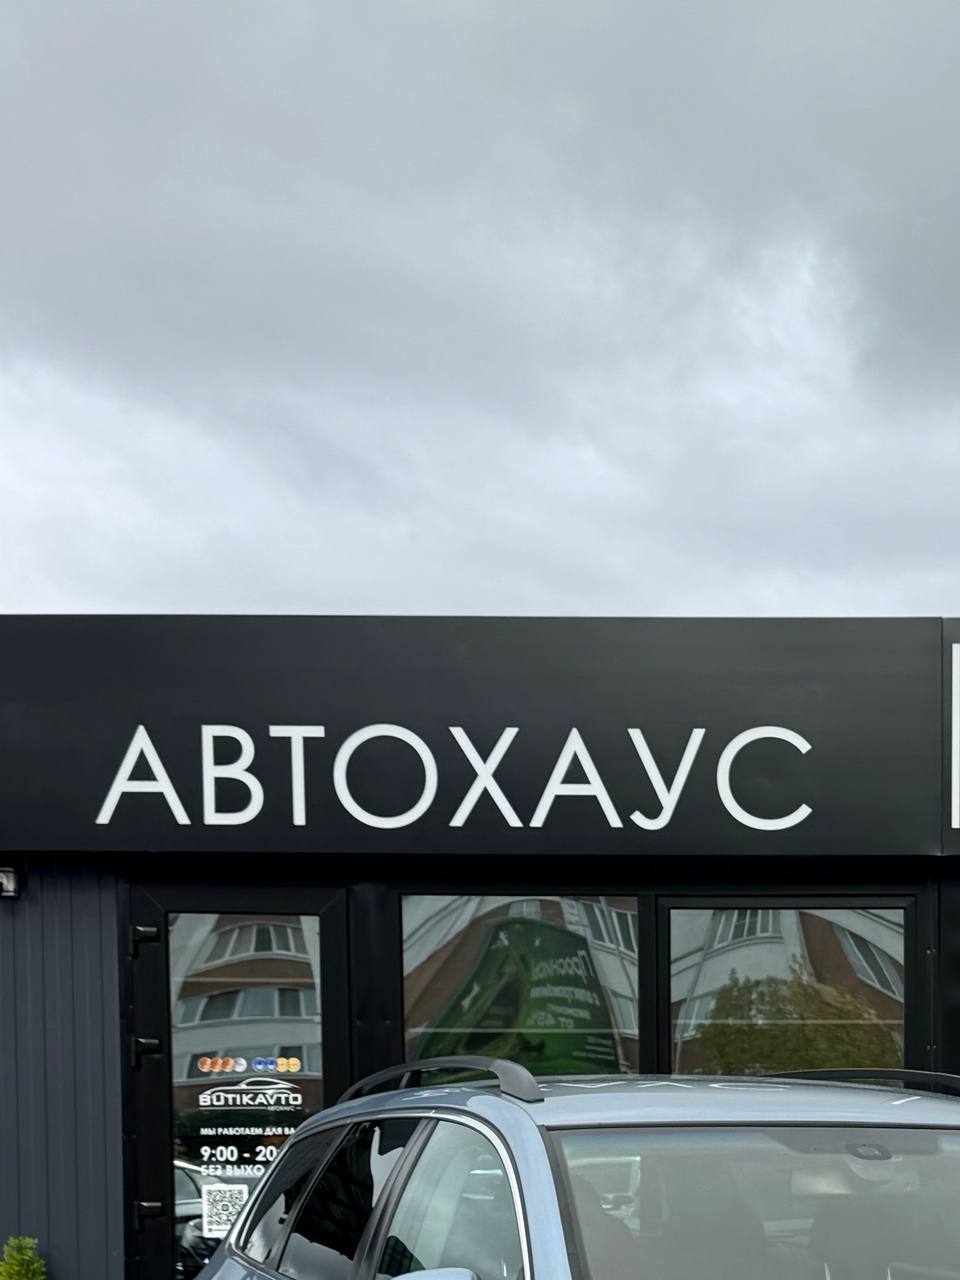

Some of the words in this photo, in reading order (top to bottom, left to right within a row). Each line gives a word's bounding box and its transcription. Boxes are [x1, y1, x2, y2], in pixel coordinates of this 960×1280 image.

[95, 724, 812, 830] АВТОХАУС
[199, 1093, 302, 1106] BUTIKAVTO
[200, 1127, 217, 1136] МЫ
[218, 1127, 263, 1136] РАБОТАЕМ
[264, 1127, 282, 1136] ДЛЯ
[284, 1127, 296, 1135] ВА
[200, 1145, 239, 1162] 9:00
[225, 1165, 266, 1176] ВЫХО
